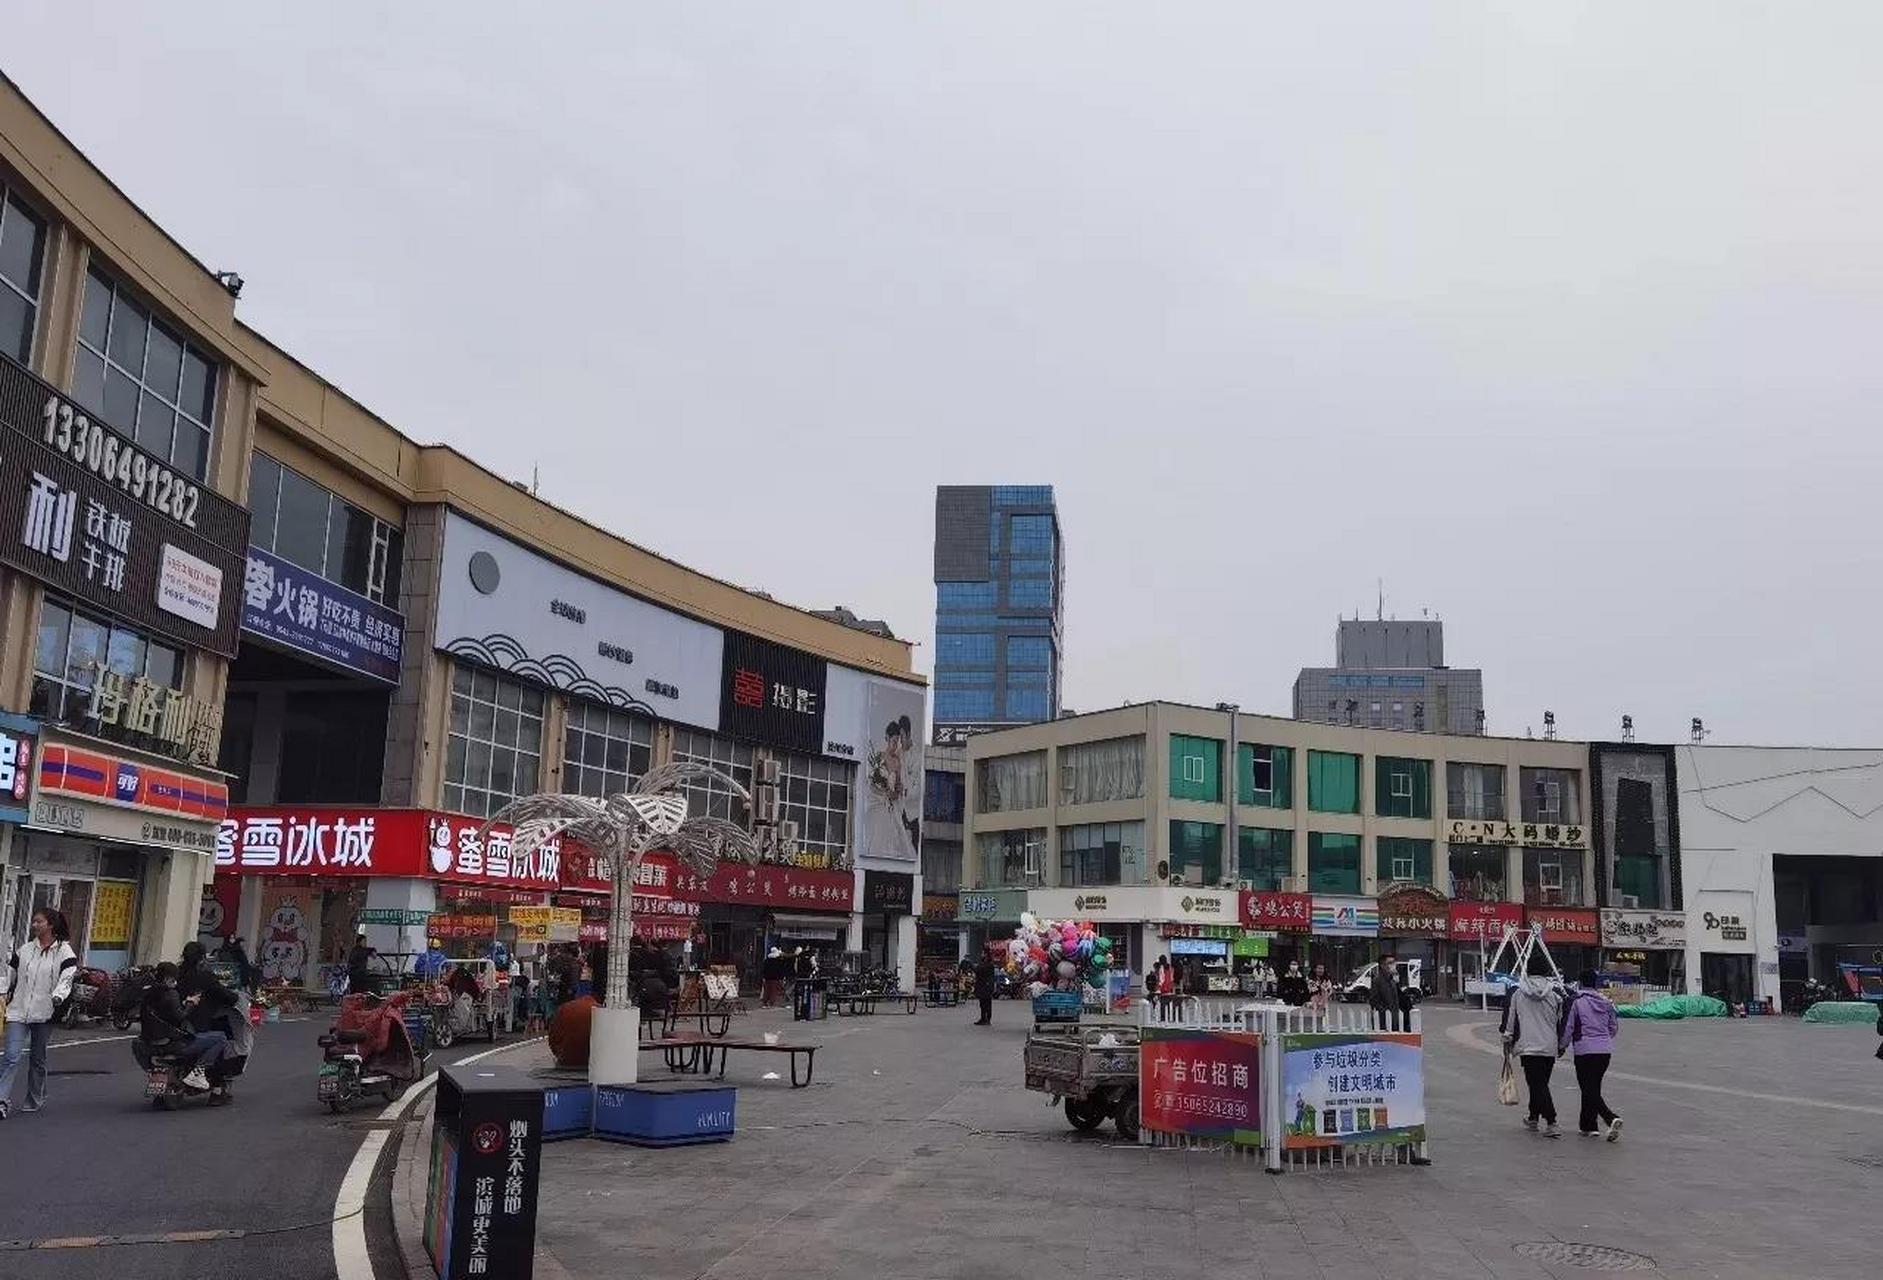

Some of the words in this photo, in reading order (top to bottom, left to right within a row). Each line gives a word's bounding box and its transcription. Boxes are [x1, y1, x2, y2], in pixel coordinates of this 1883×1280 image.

[43, 396, 199, 528] 13306491282
[24, 470, 77, 563] 利
[1153, 1056, 1249, 1089] 广告位招商
[1313, 1050, 1382, 1070] 参与垃圾分类
[1328, 1073, 1397, 1093] 创建文明城市
[503, 1119, 528, 1215] 烟头不落地
[468, 1176, 496, 1274] 滨城更美丽
